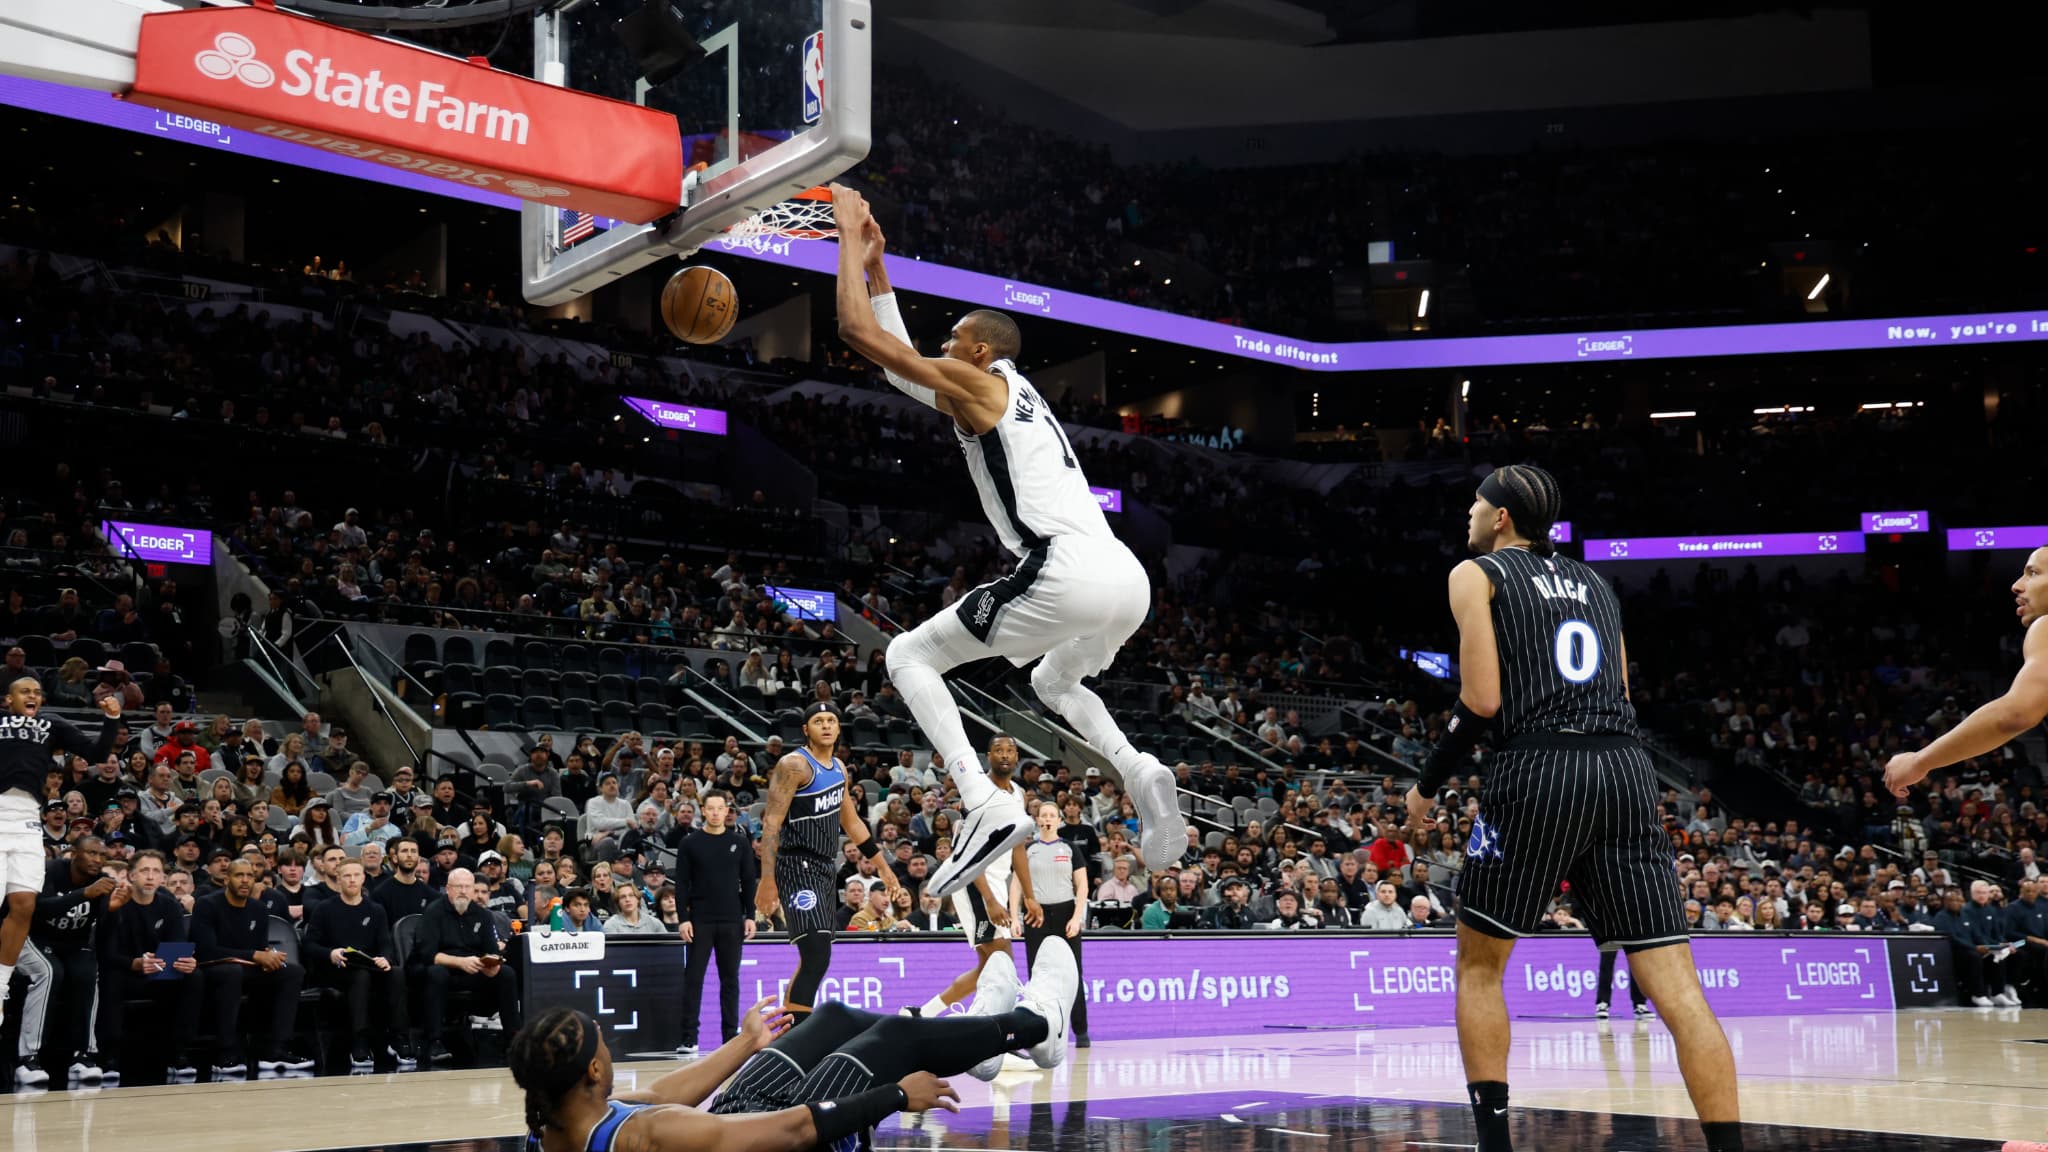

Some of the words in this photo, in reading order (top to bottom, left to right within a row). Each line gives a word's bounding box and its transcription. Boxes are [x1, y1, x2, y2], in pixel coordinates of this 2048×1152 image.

[166, 112, 221, 136] LEDGER
[184, 283, 209, 298] 107
[1011, 290, 1045, 306] LEDGER
[1888, 326, 1937, 339] Now,
[1951, 321, 2018, 339] you're
[1234, 335, 1271, 354] Trade
[1274, 343, 1339, 364] different
[1585, 340, 1625, 352] LEDGER
[658, 410, 690, 422] LEDGER
[1044, 415, 1076, 469] 1
[1878, 517, 1913, 527] LEDGER
[131, 535, 185, 551] LEDGER
[1531, 574, 1588, 605] BLACK
[1554, 618, 1601, 683] 0
[18, 728, 29, 740] 8
[540, 942, 589, 952] GATORADE
[1369, 966, 1456, 994] LEDGER
[1796, 962, 1862, 986] LEDGER
